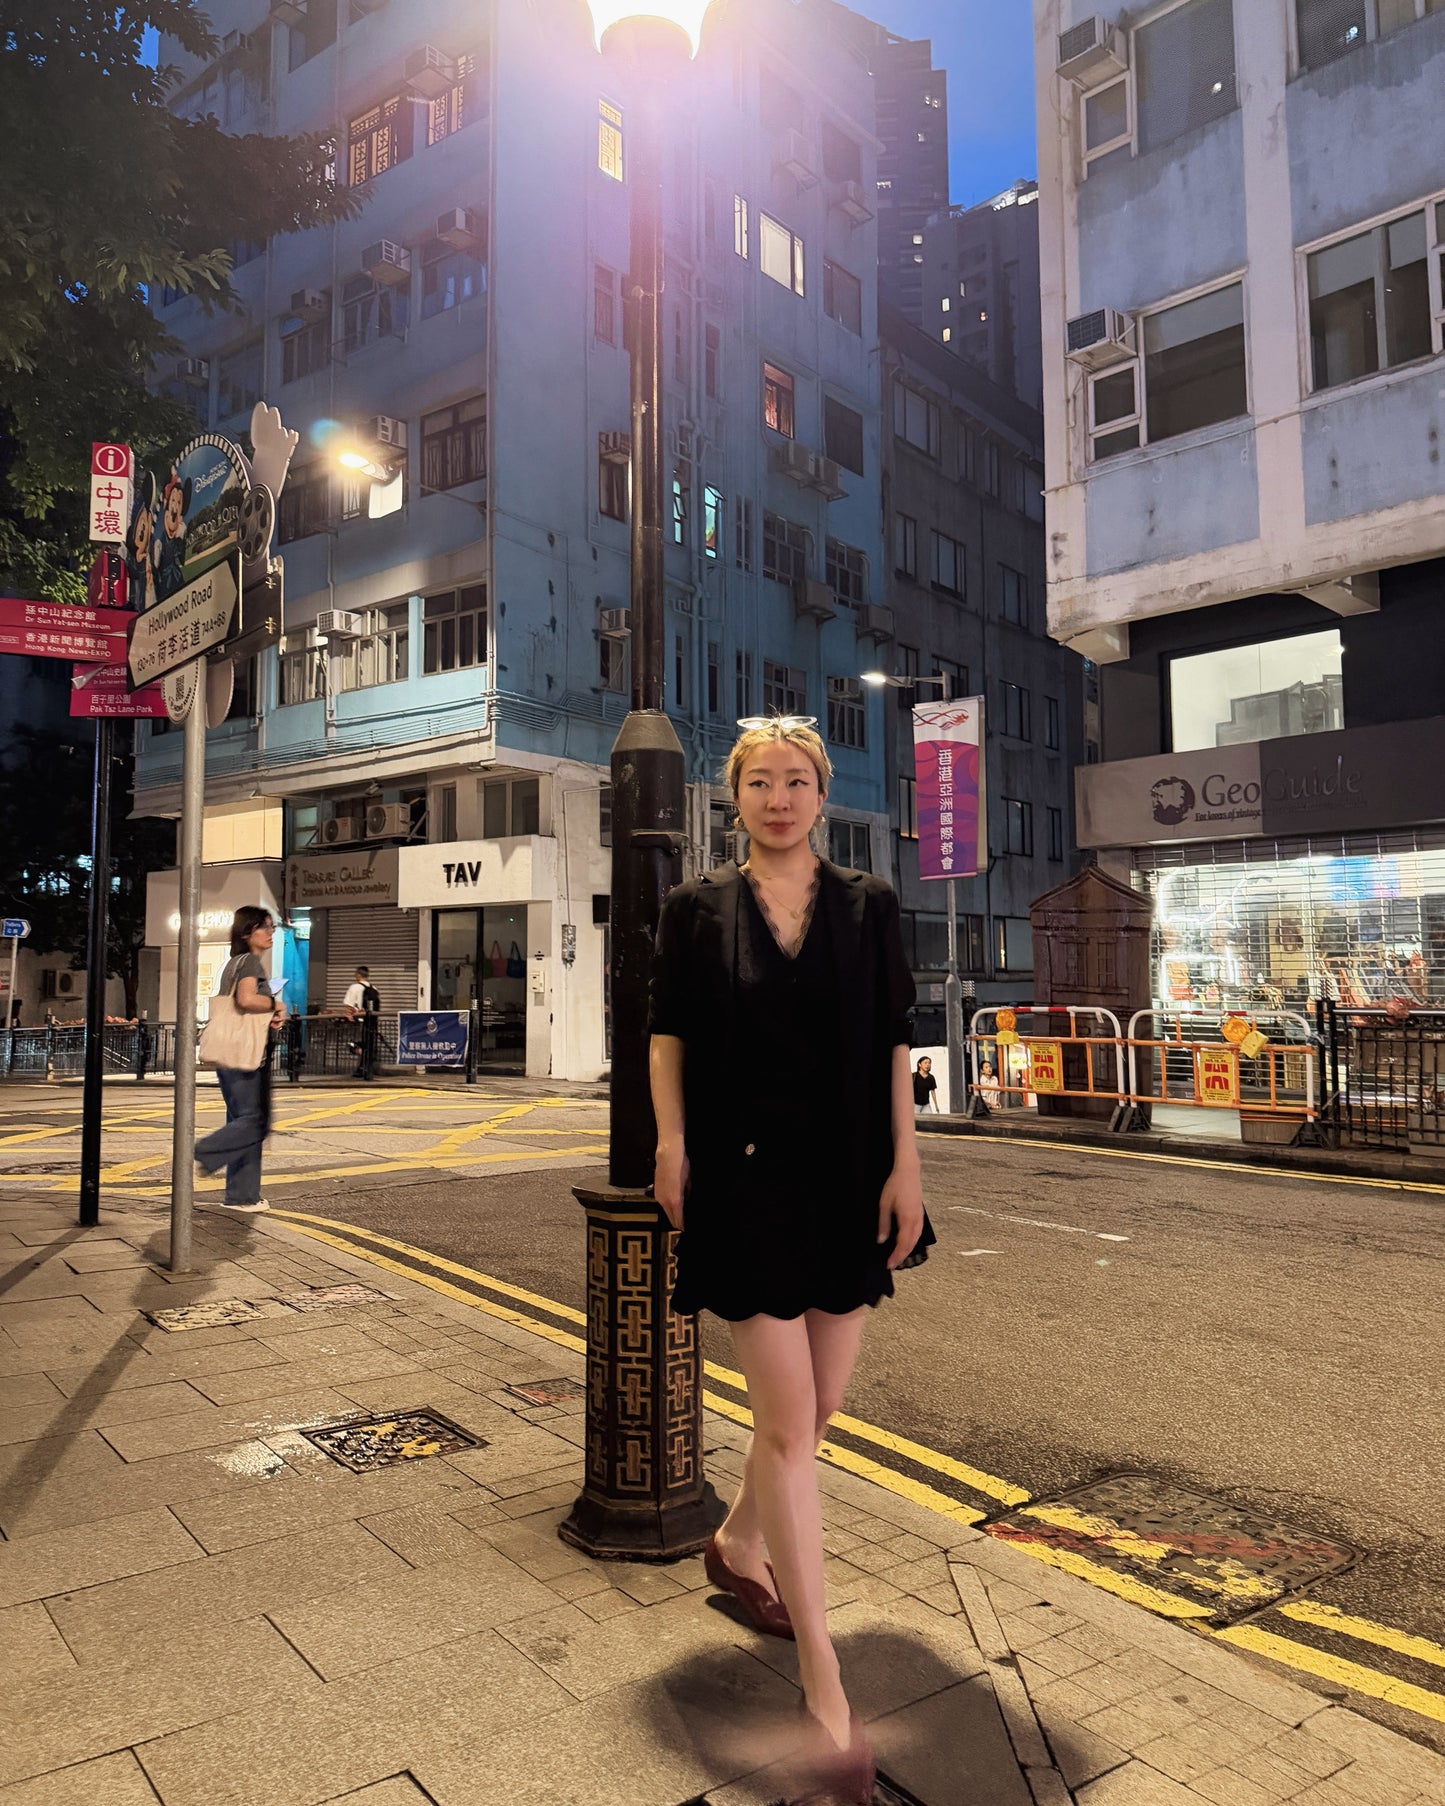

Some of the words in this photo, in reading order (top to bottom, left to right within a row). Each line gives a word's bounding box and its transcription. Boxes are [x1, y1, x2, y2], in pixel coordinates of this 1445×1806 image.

[94, 481, 124, 536] 中環
[148, 594, 189, 636] Hollywood
[191, 579, 213, 610] Road
[37, 616, 51, 625] Sun
[81, 621, 111, 631] Museum
[25, 643, 45, 652] Hong
[47, 644, 67, 655] Kong
[68, 647, 112, 658] News-EXPO
[158, 617, 200, 665] 荷李活道
[90, 705, 103, 713] Pak
[137, 705, 153, 714] Park
[938, 748, 954, 870] 香港亞洲國際都會
[1228, 808, 1237, 822] of
[442, 861, 482, 884] TAV
